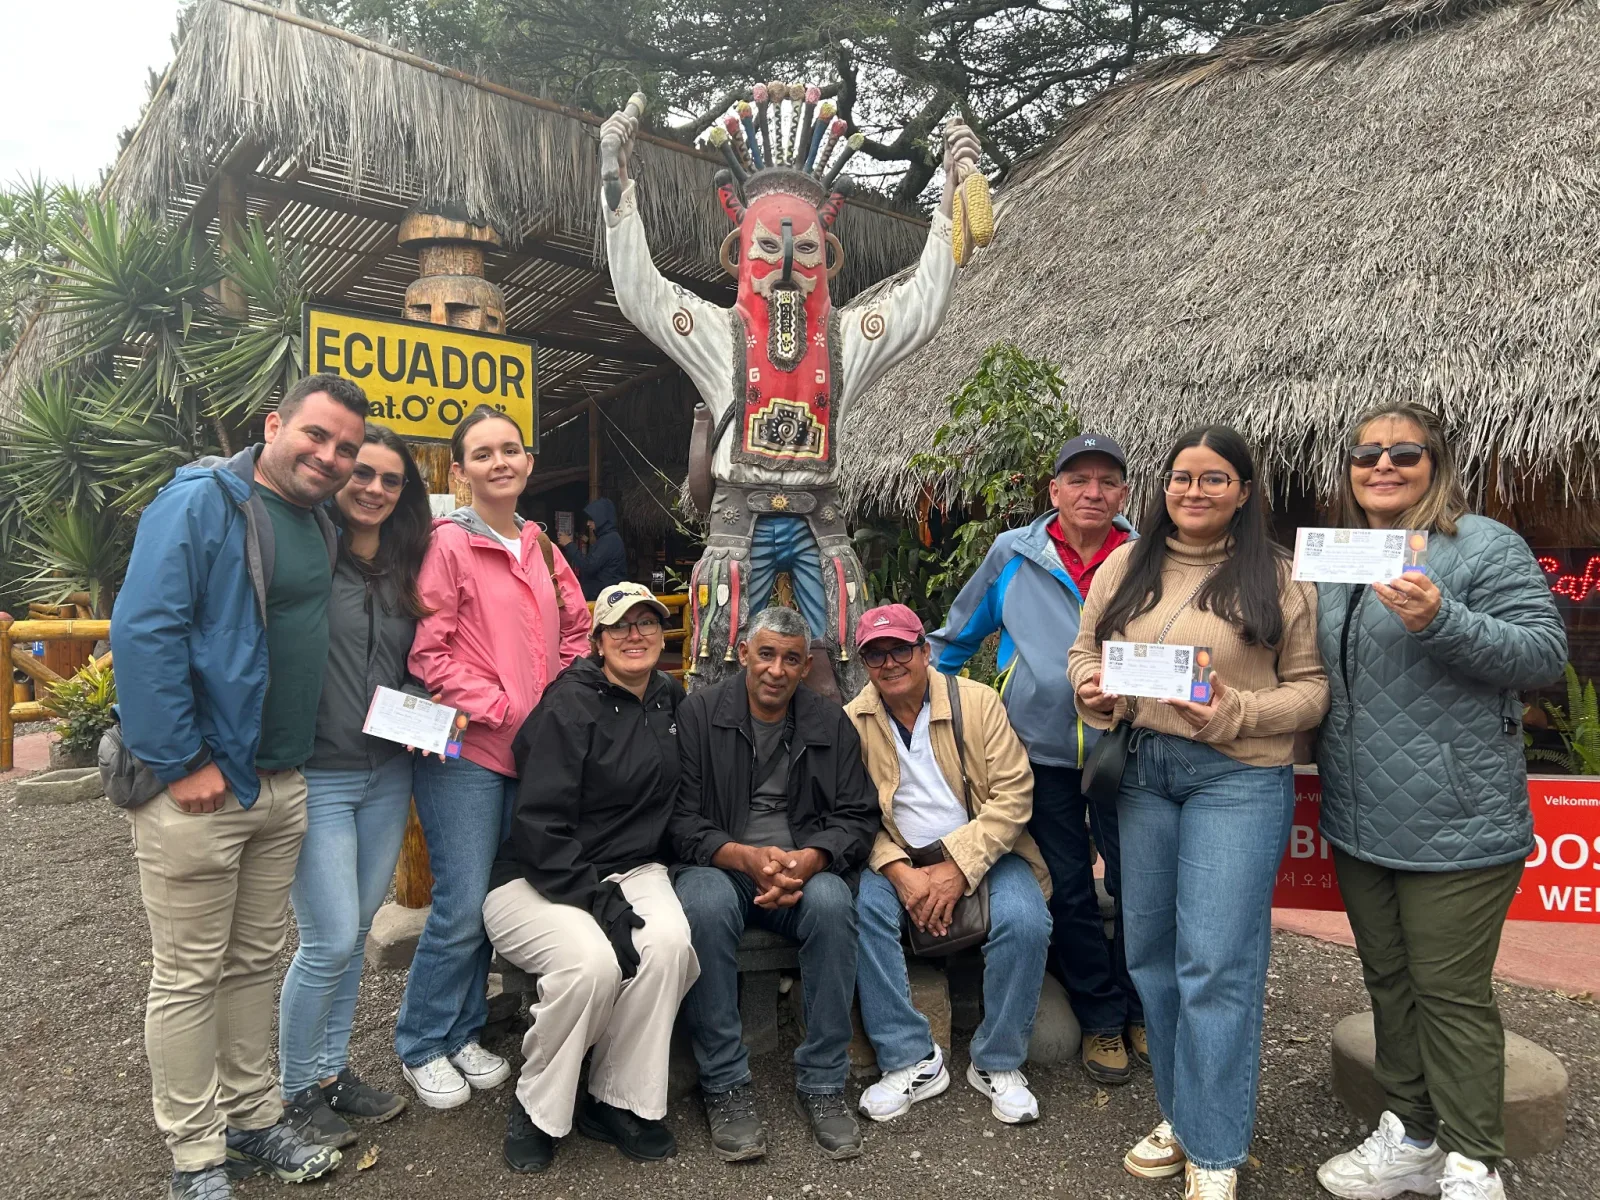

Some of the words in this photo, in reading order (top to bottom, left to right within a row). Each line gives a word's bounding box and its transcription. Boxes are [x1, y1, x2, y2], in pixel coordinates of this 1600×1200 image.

[316, 326, 525, 399] ECUADOR
[1295, 792, 1322, 802] M-VI
[1524, 833, 1600, 870] DO
[1538, 884, 1600, 913] WE
